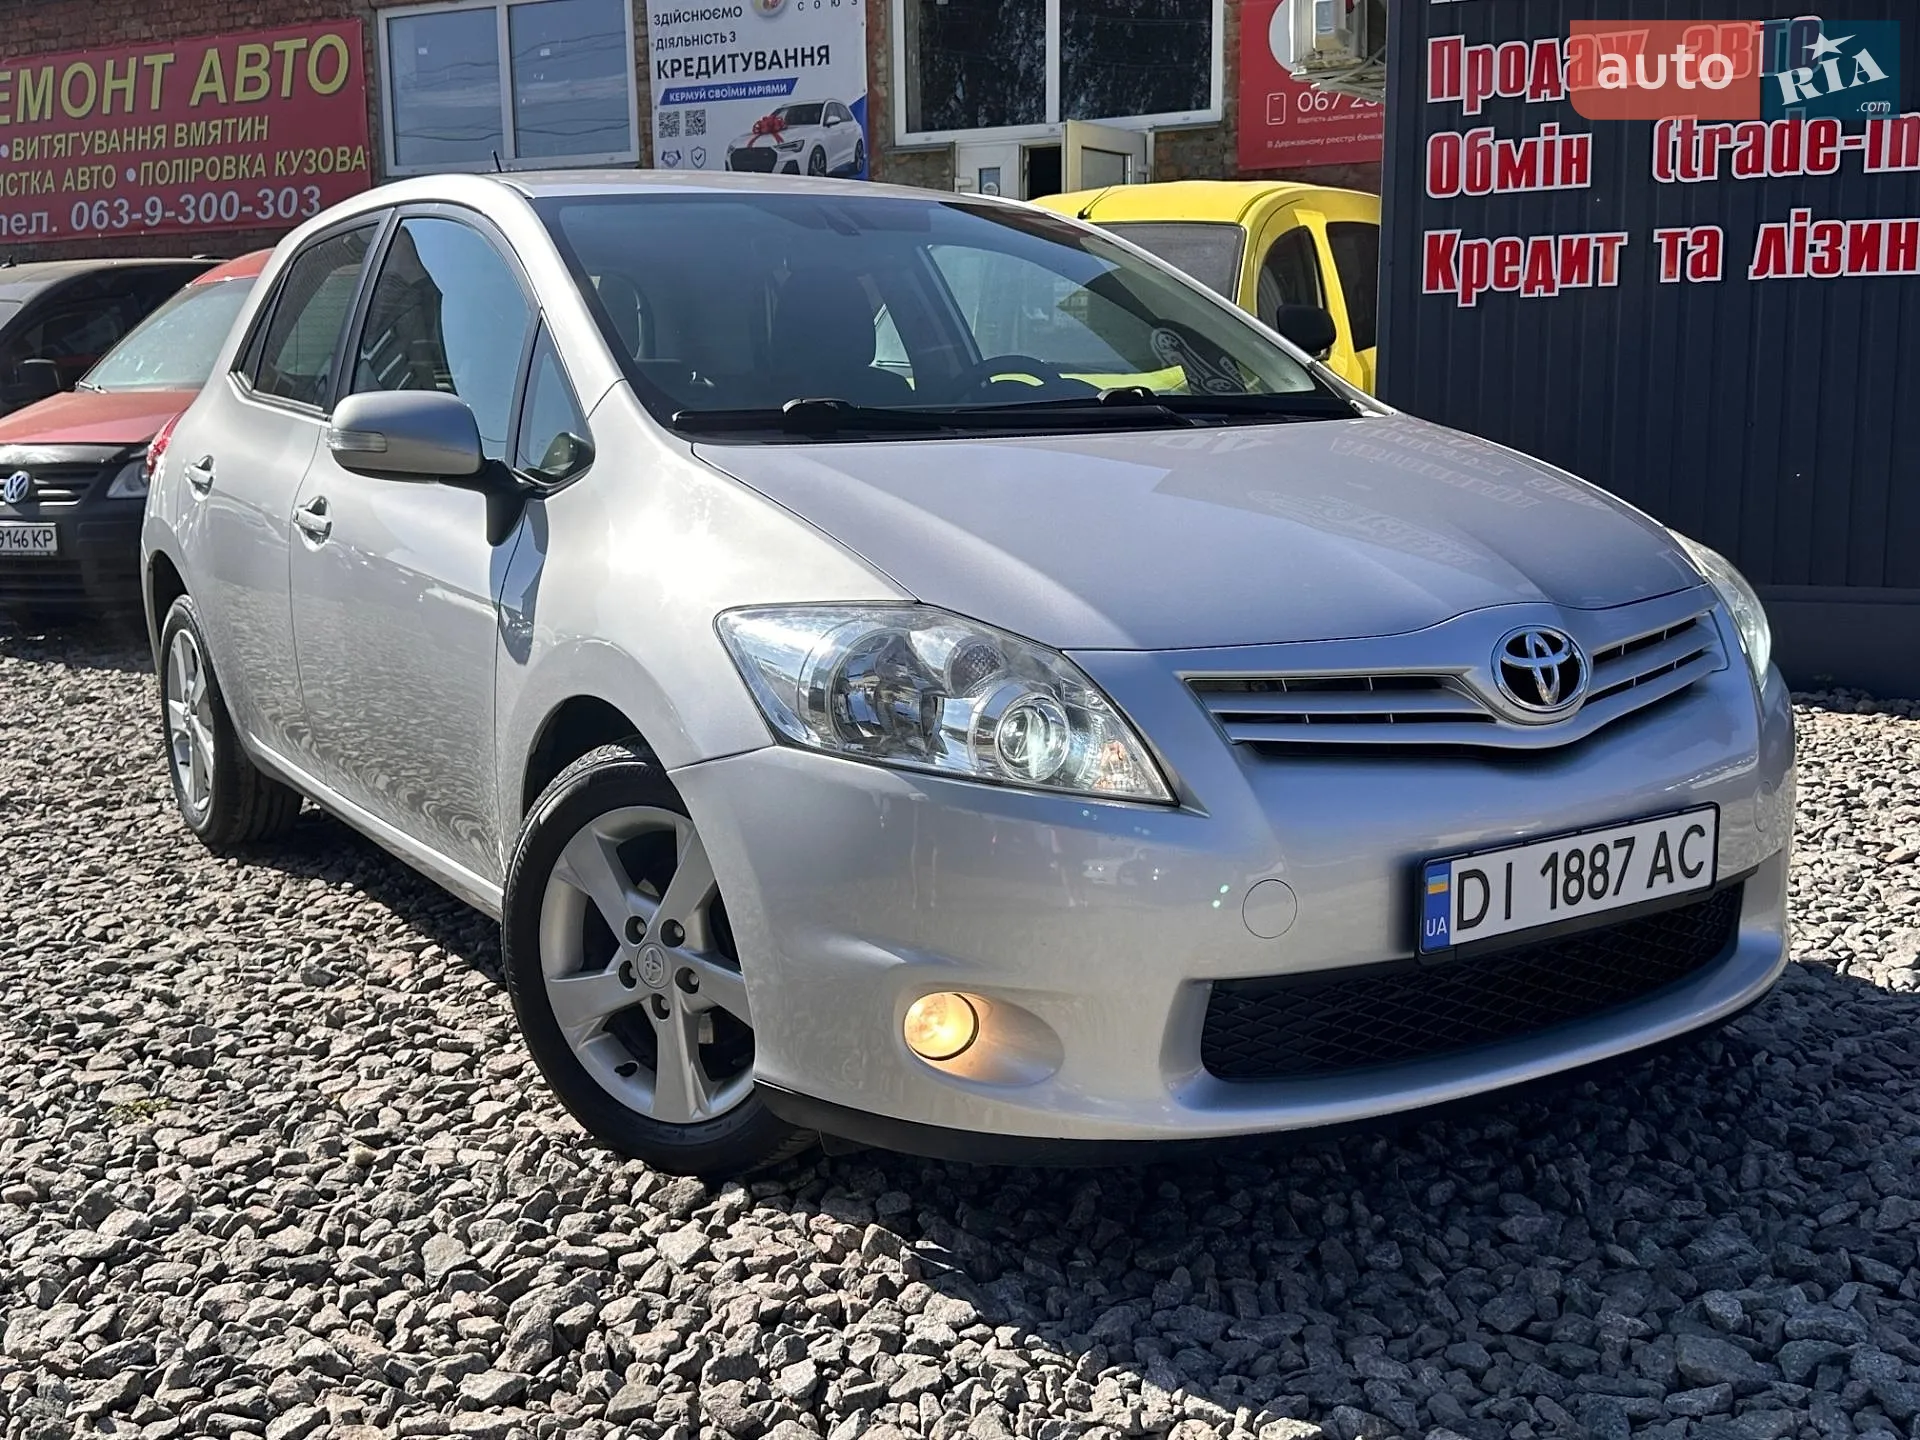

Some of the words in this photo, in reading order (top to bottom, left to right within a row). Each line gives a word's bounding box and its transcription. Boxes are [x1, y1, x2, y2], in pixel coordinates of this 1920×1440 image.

[654, 6, 742, 26] ЗДІЙСНЮЄМО
[656, 33, 726, 51] ДІЯЛЬНІСТЬ
[657, 45, 830, 80] КРЕДИТУВАННЯ
[190, 34, 349, 106] АВТО
[669, 89, 706, 102] КЕРМУЙ
[708, 86, 746, 98] СВОЇМИ
[748, 83, 788, 96] МРІЯМИ
[1428, 29, 1649, 116] Продаж
[12, 125, 166, 161] ВИТЯГУВАННЯ
[174, 115, 268, 148] ВМЯТИН
[1426, 123, 1592, 198] Обмін
[0, 169, 55, 197] СТКА
[62, 164, 116, 192] АВТО
[140, 153, 266, 186] ПОЛІРОВКА
[274, 145, 366, 176] КУЗОВА
[71, 185, 321, 231] 063-9-300-303
[1422, 229, 1628, 308] Кредит
[1653, 226, 1724, 283] та
[1748, 208, 1920, 280] лізин
[32, 529, 53, 548] KP
[1457, 862, 1513, 930] DI
[1540, 836, 1635, 910] 1887
[1646, 824, 1705, 888] AC
[1426, 917, 1447, 936] UA
